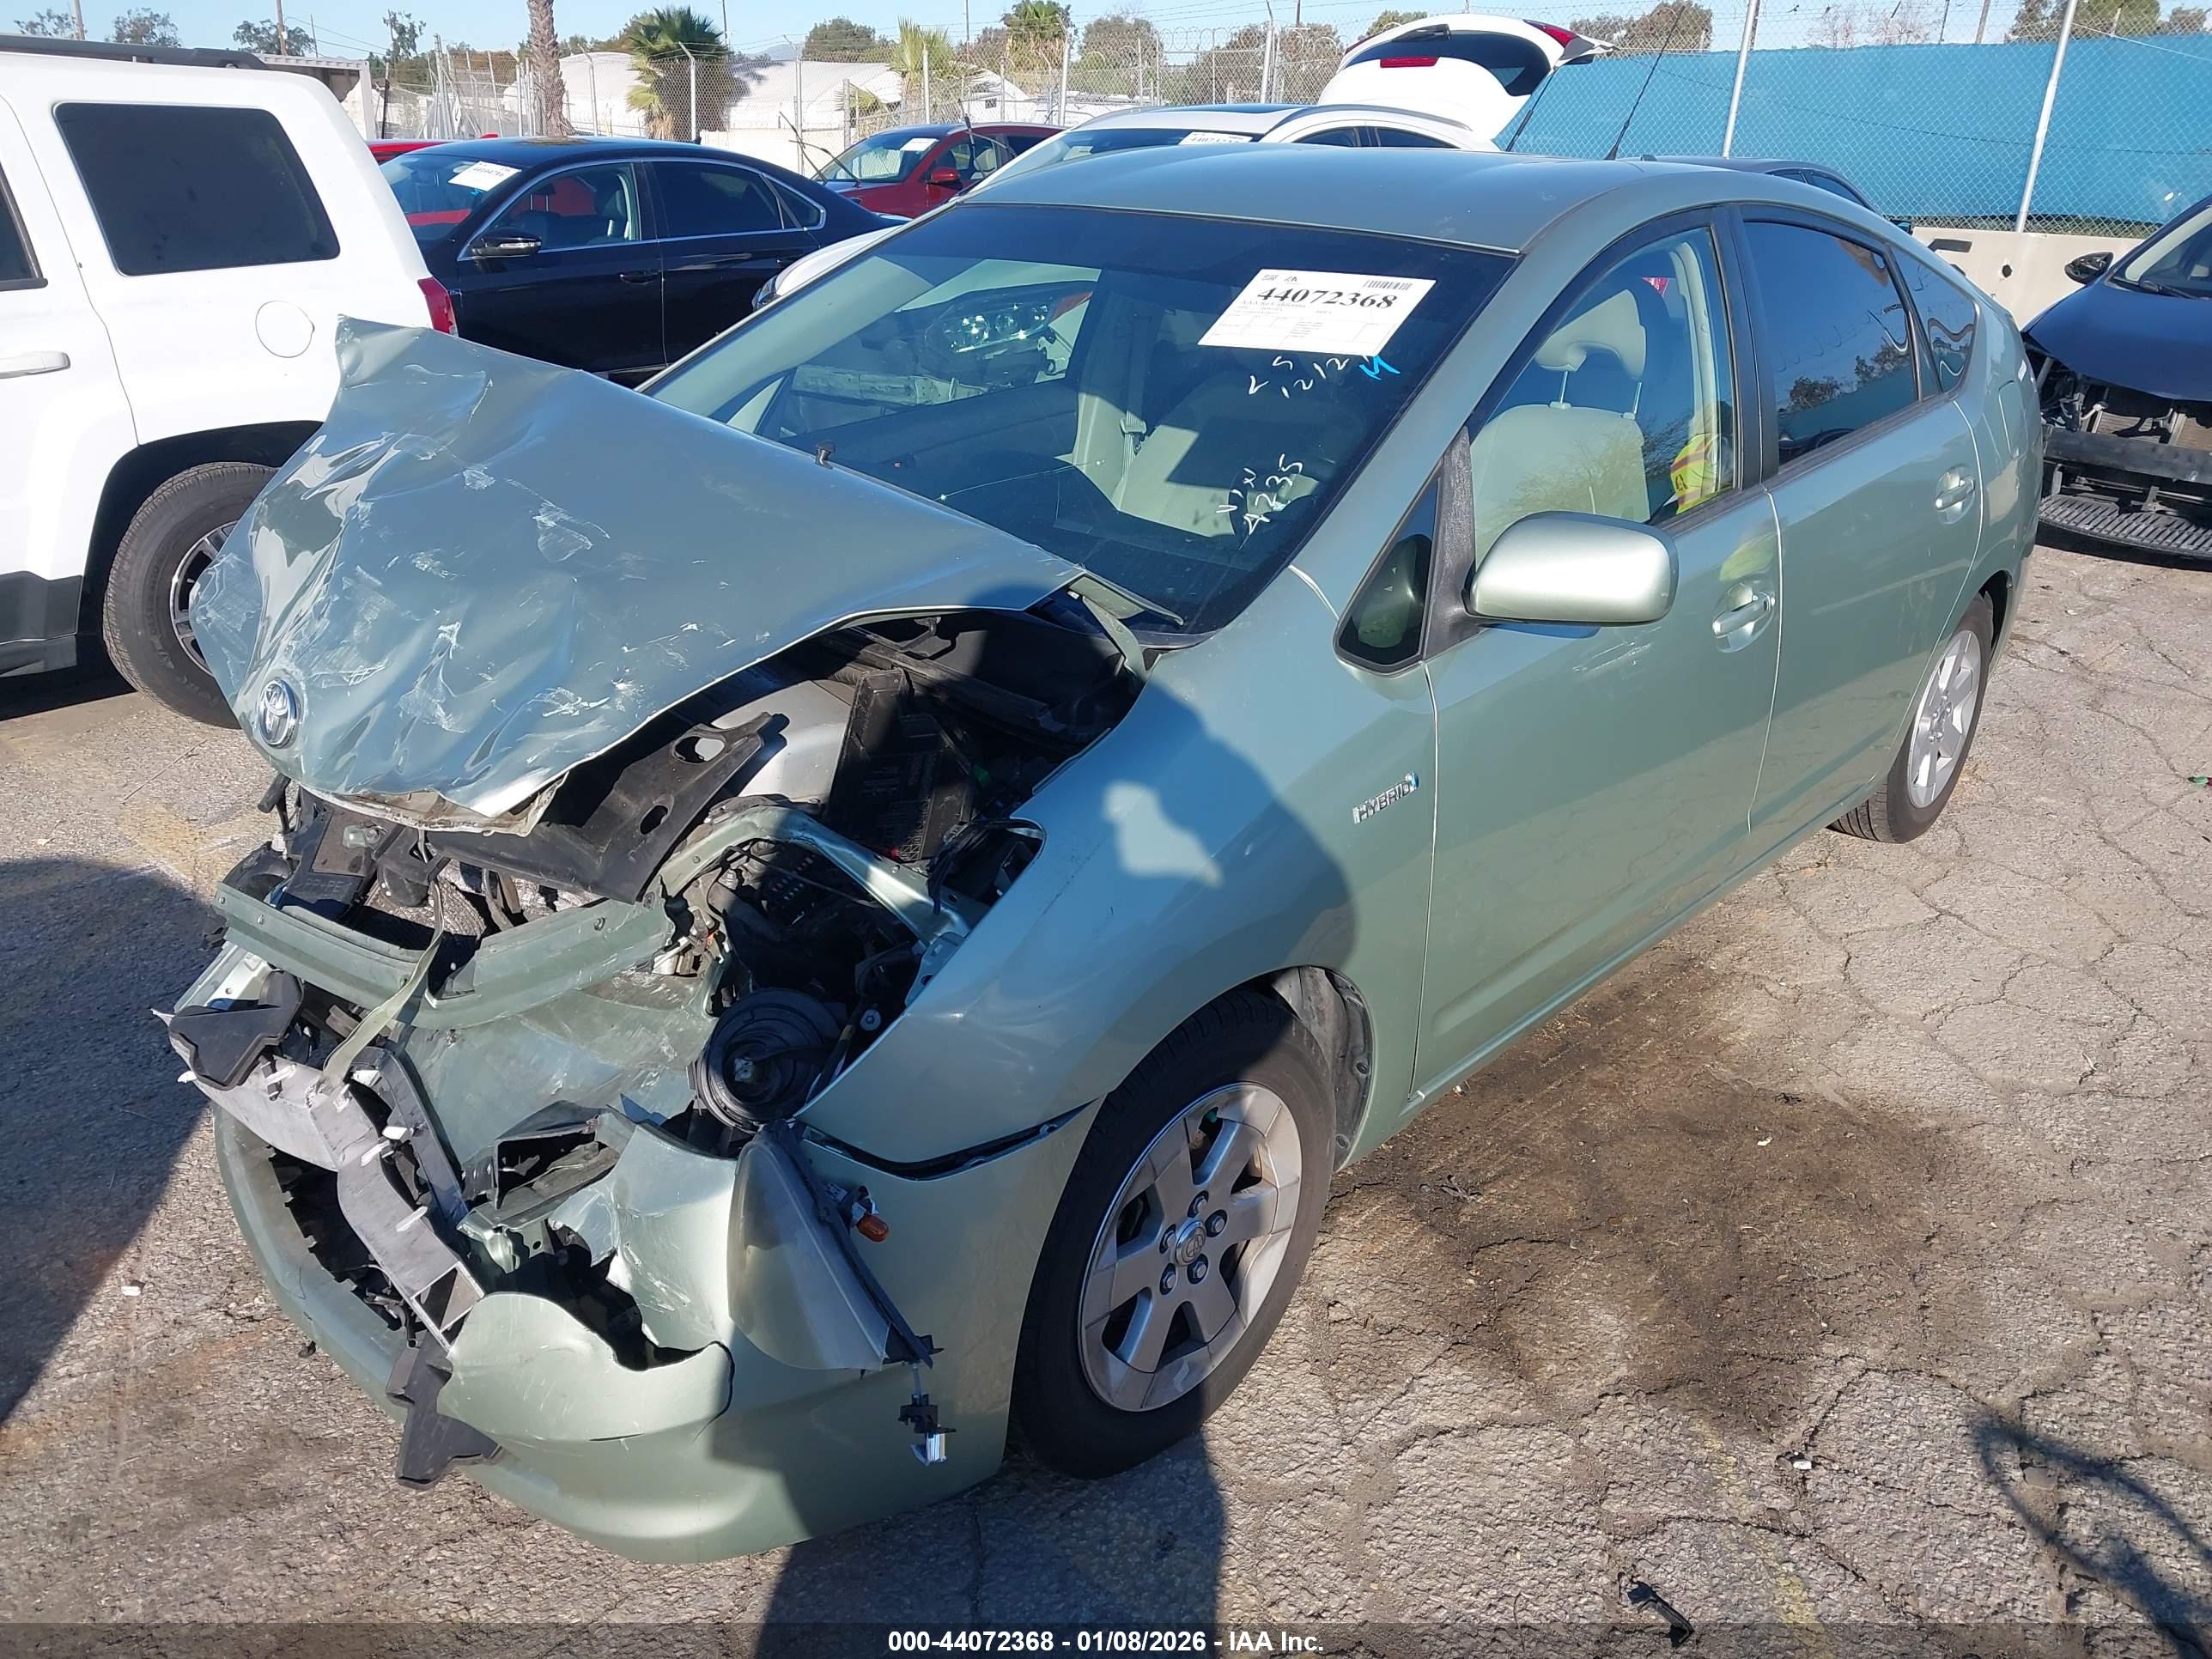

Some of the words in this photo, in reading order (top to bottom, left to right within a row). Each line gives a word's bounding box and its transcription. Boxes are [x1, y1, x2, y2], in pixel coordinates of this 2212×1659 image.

[1256, 287, 1399, 309] 44072368
[1243, 453, 1304, 536] 4235
[1352, 777, 1414, 825] HYBRID
